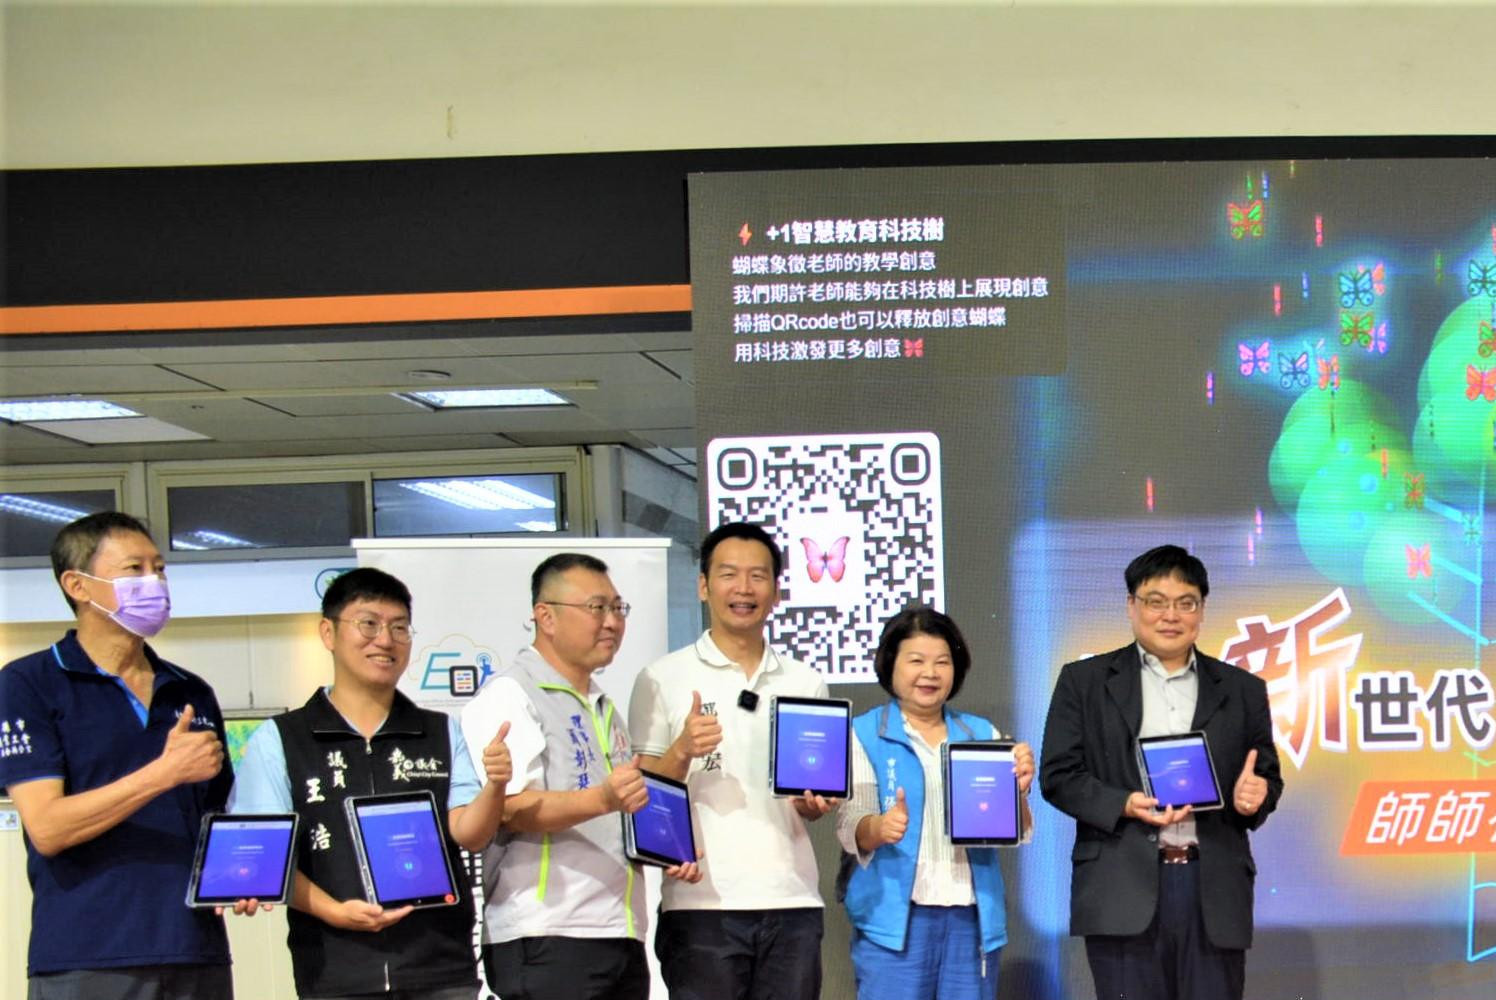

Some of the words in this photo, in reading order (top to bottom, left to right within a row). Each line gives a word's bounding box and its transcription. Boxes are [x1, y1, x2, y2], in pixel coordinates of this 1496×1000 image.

[766, 217, 944, 244] +1智慧教育科技樹
[732, 251, 936, 275] 蝴蝶象徵老師的教學創意
[733, 277, 1048, 304] 我們期許老師能夠在科技樹上展現創意
[733, 307, 1006, 333] 掃描QRcode也可以釋放創意蝴蝶
[735, 338, 901, 362] 用科技激發更多創意
